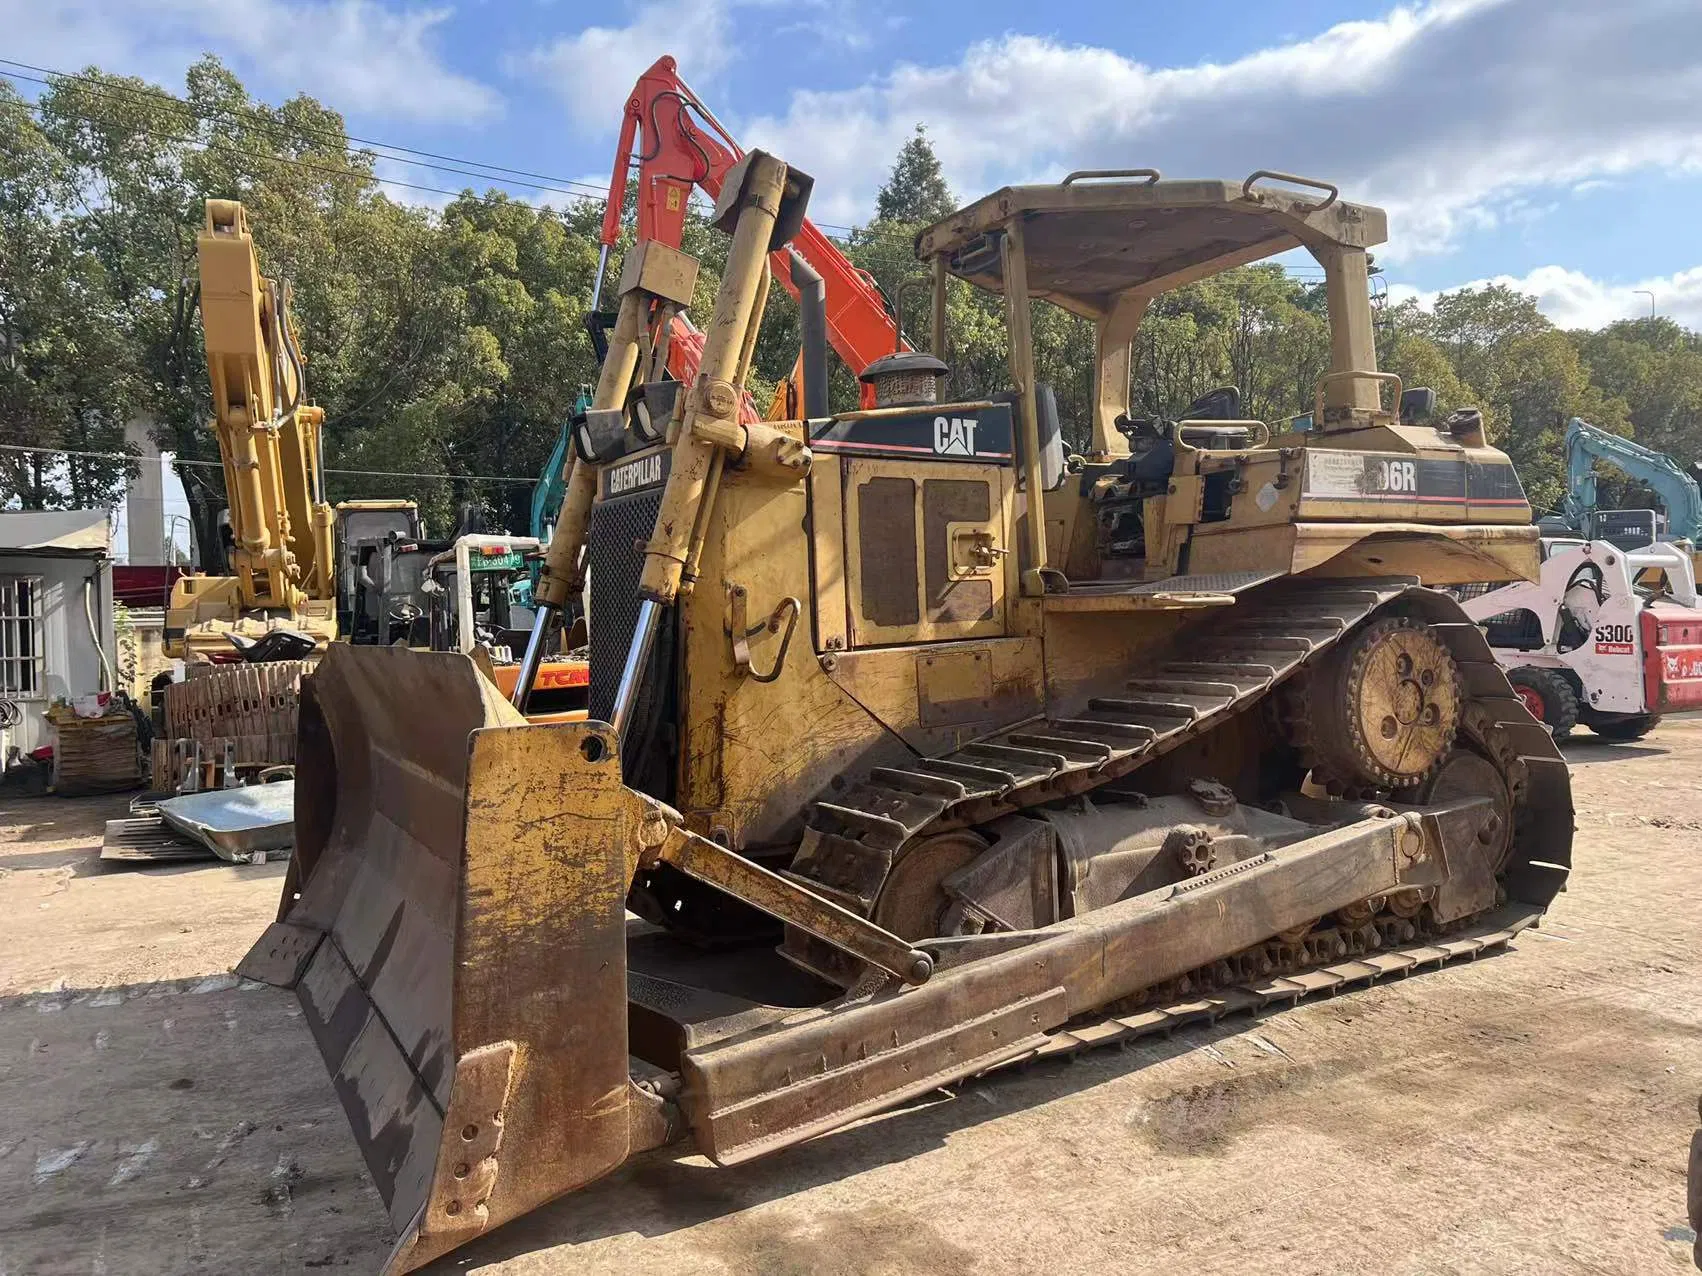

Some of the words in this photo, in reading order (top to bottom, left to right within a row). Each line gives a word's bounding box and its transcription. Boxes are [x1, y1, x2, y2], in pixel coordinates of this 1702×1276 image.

[933, 416, 979, 456] CAT
[610, 454, 661, 494] CATERPILLAR
[1595, 624, 1634, 643] S300
